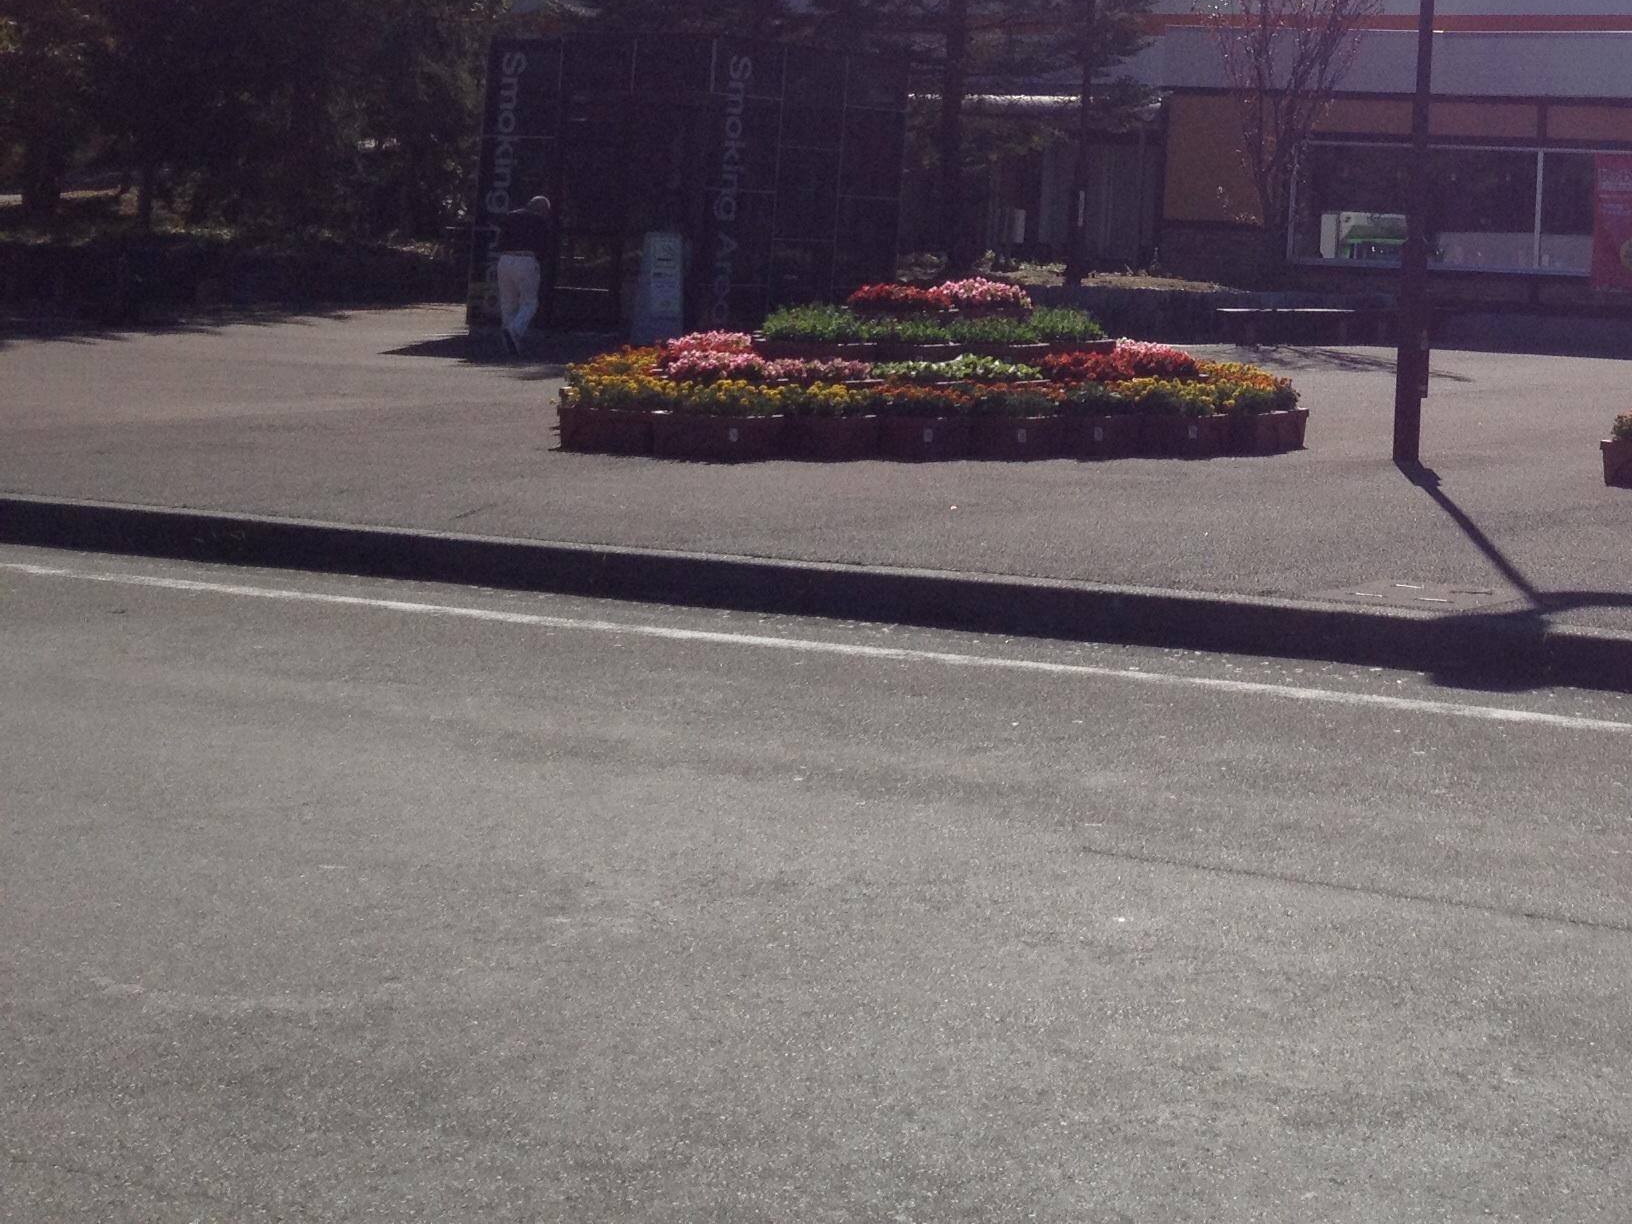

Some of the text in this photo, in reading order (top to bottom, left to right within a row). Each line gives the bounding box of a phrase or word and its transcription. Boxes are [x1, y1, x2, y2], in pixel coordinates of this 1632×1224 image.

[485, 51, 528, 215] Smoking
[711, 55, 752, 324] Smoking Area
